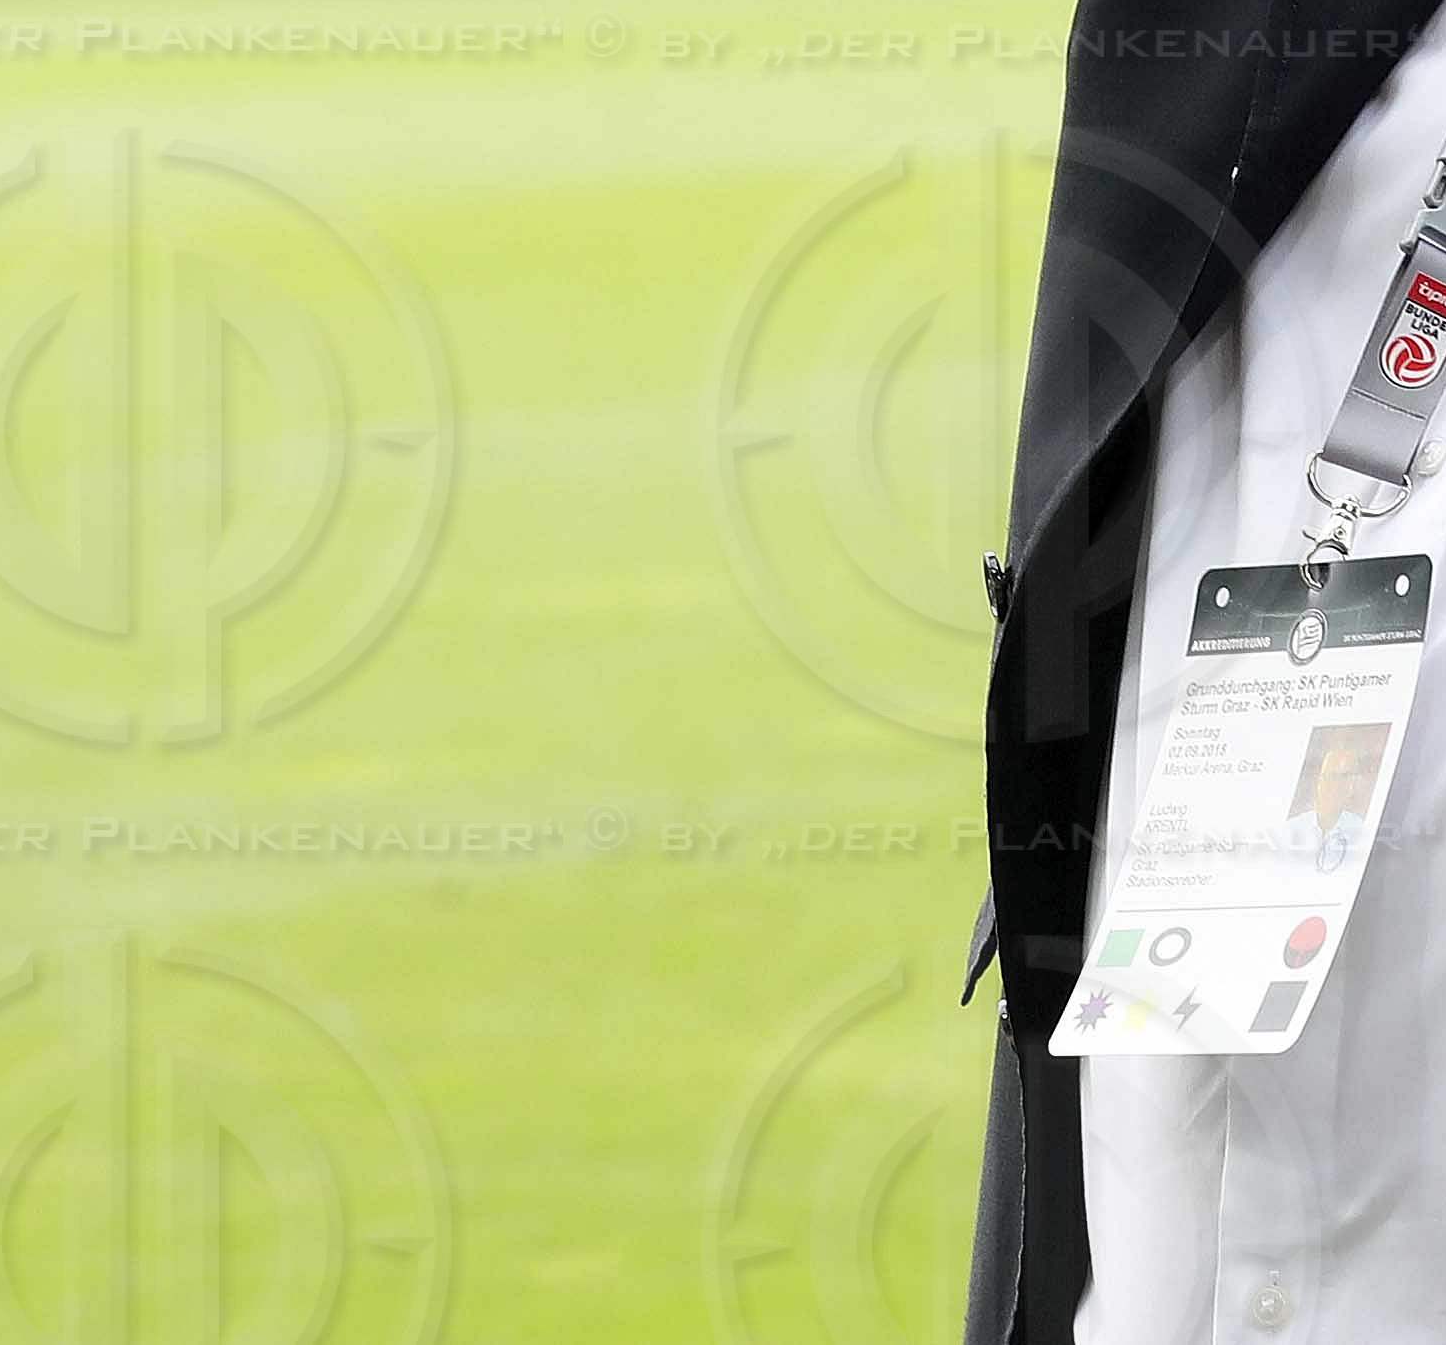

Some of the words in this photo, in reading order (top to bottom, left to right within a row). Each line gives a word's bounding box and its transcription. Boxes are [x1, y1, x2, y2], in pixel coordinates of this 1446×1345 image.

[1411, 318, 1439, 340] LIGA
[1298, 675, 1317, 689] SK
[1260, 696, 1280, 711] SK
[1282, 693, 1319, 711] Rapid
[1321, 691, 1354, 709] Wien
